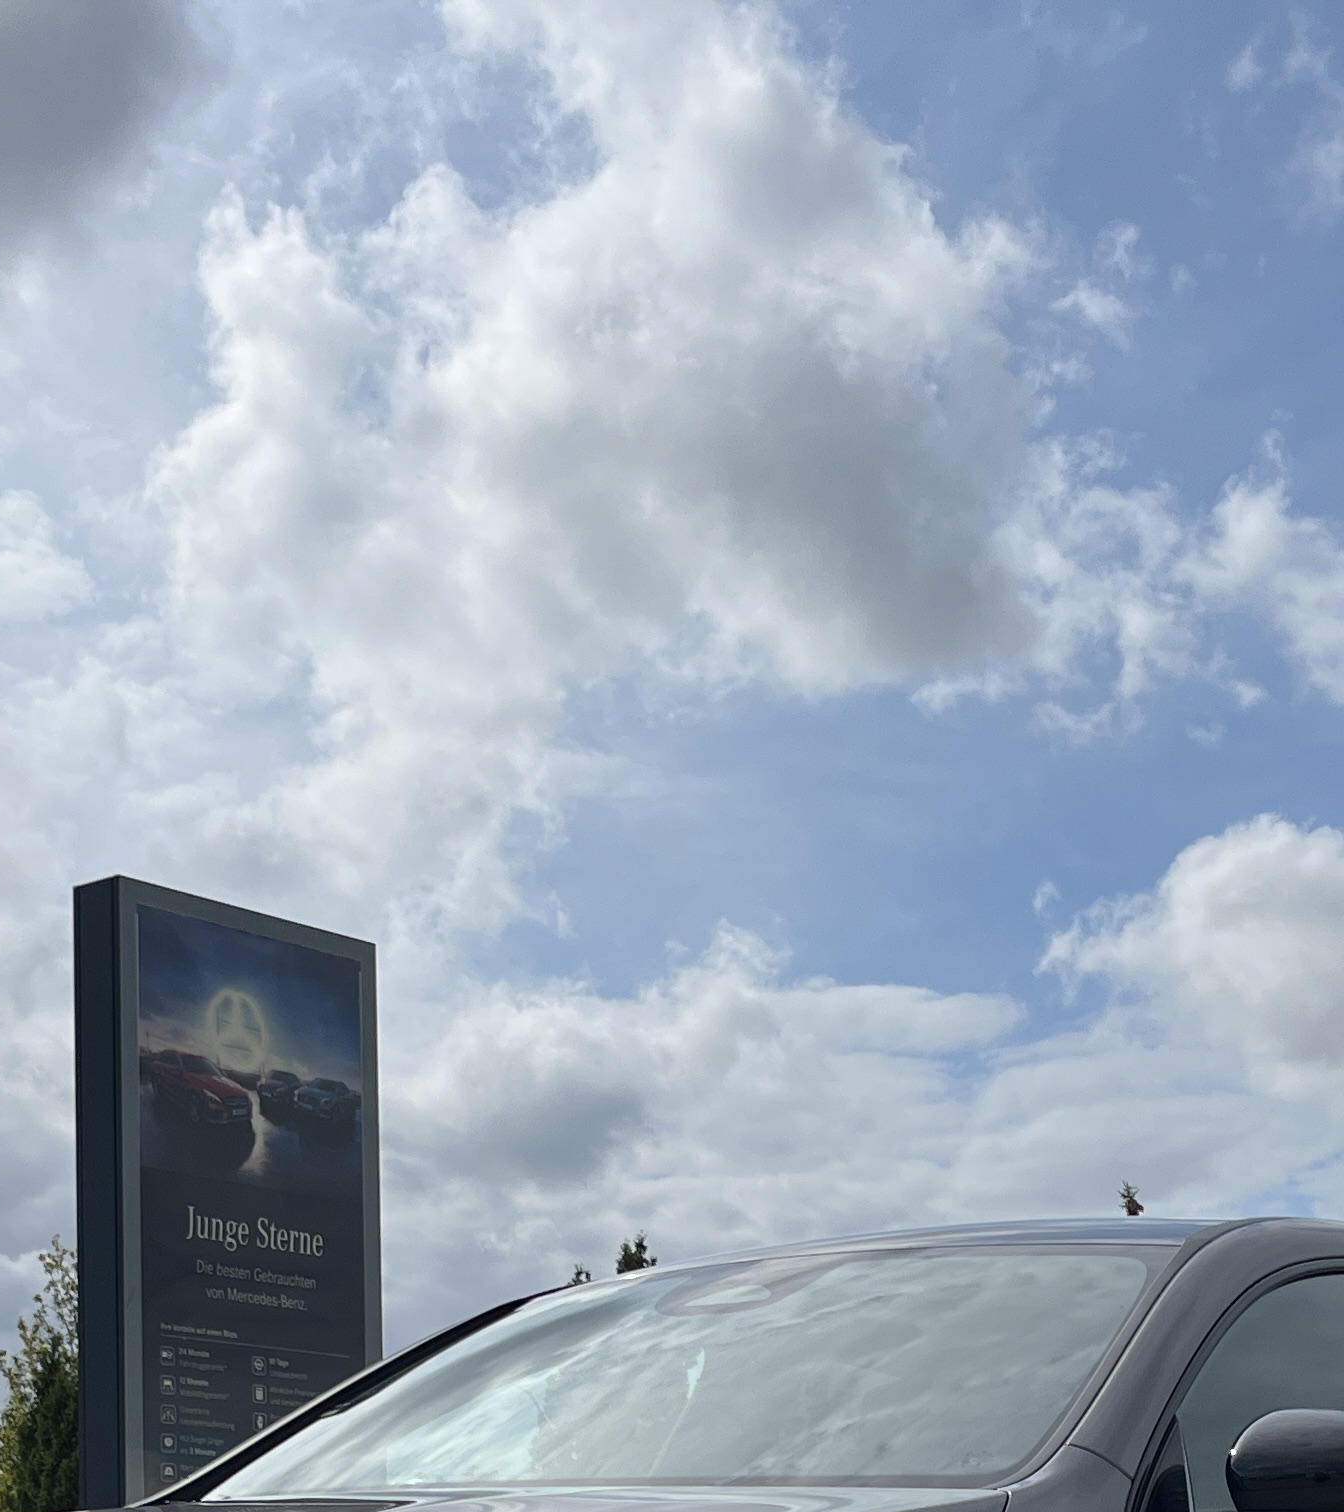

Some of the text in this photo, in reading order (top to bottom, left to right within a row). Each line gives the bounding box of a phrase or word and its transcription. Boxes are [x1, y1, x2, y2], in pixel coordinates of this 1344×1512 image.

[185, 1205, 324, 1257] Junge Sterne
[196, 1259, 317, 1289] Die besten Gebrauchten
[205, 1287, 225, 1300] von
